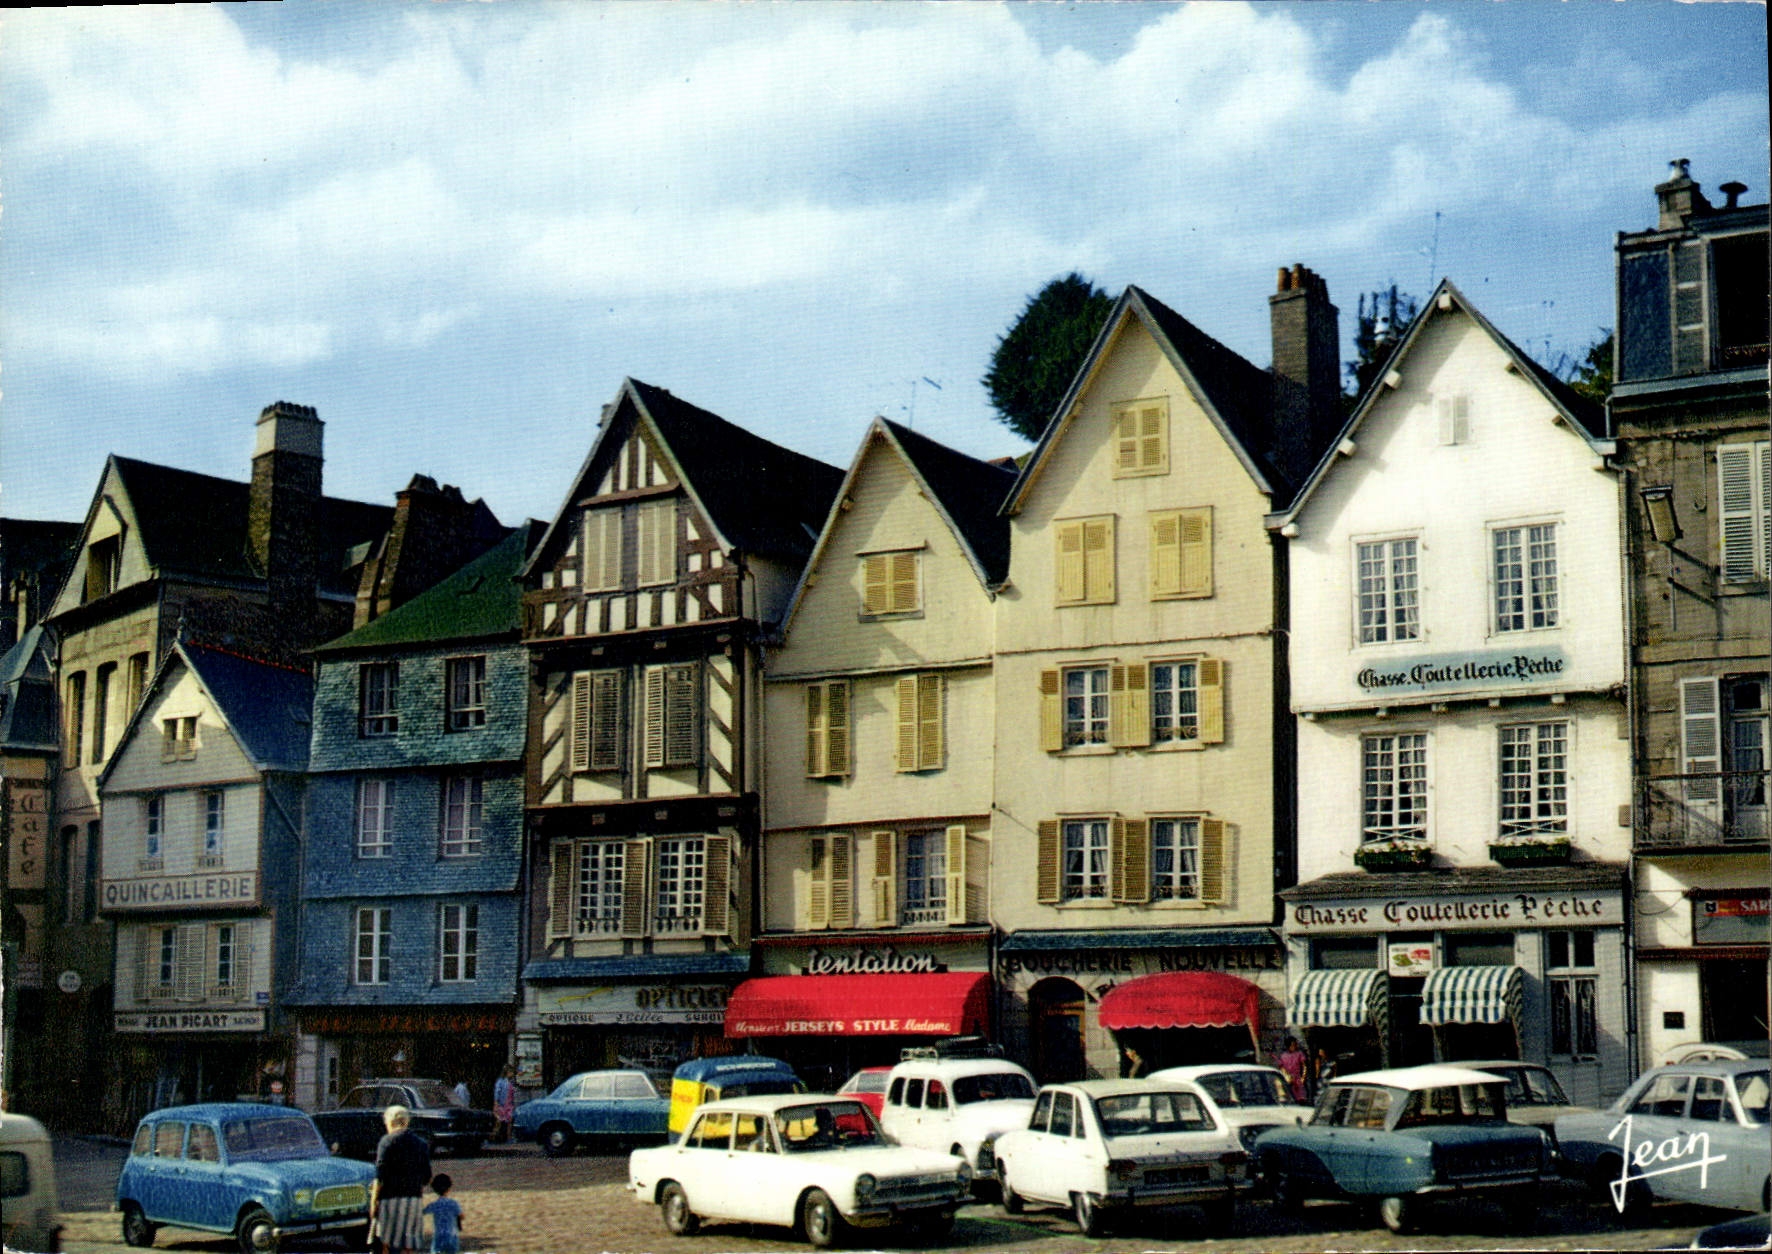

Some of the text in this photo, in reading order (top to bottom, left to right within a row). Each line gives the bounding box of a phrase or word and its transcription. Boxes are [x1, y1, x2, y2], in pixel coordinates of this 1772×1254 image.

[106, 877, 251, 904] QUINCAILLERIE
[1294, 903, 1369, 929] Chasse
[1383, 900, 1511, 927] Coutellerie
[1007, 950, 1282, 972] BOUCHERIE NOUVELLE
[145, 1014, 177, 1028] JEAN
[782, 1020, 845, 1033] JERSEYS
[853, 1019, 900, 1032] STYLE
